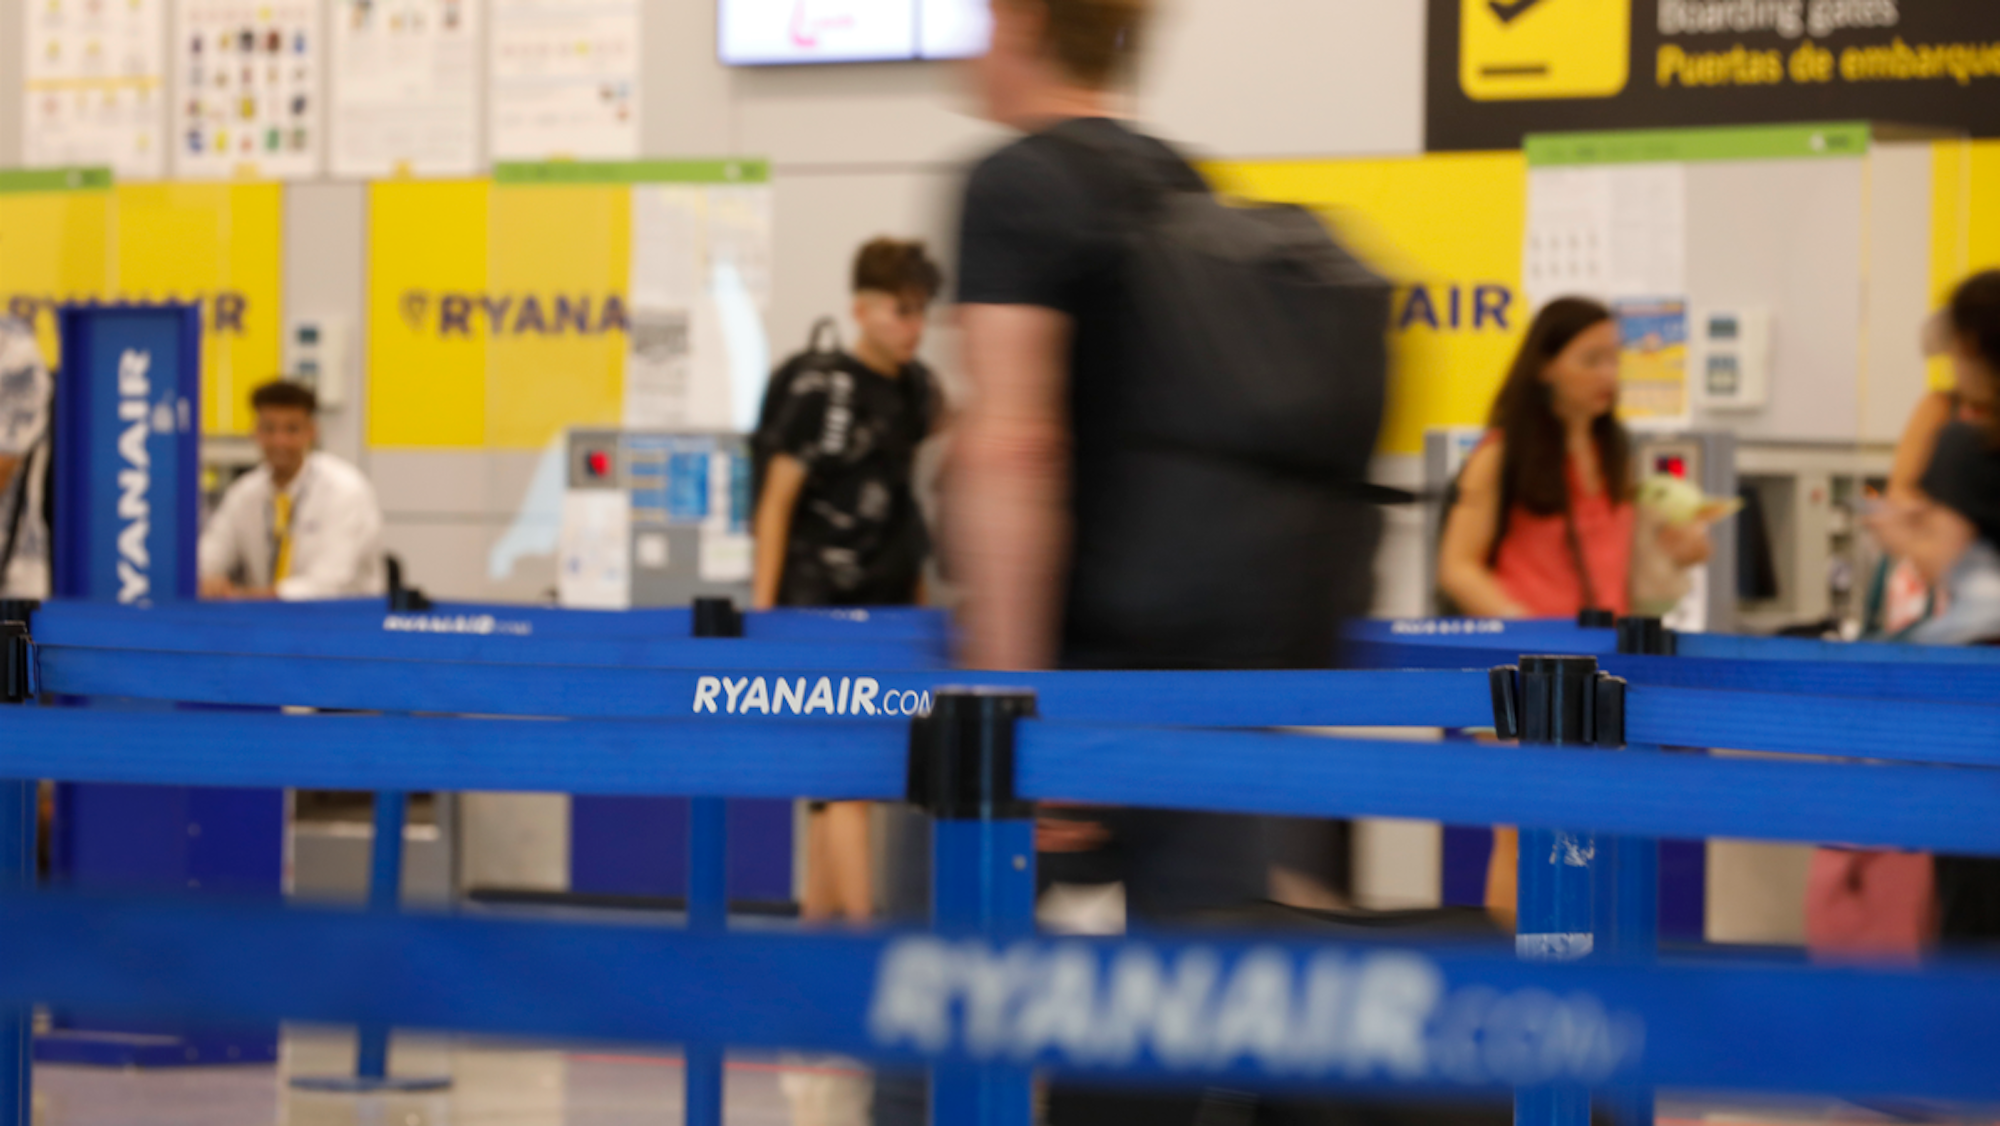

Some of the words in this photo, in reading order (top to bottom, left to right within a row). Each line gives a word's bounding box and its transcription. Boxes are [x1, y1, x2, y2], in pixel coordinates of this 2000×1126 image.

[1806, 0, 1899, 37] gates
[1655, 44, 1783, 86] Puertas
[1789, 40, 1834, 82] de
[440, 294, 631, 335] RYANA
[117, 349, 150, 608] YANAIR
